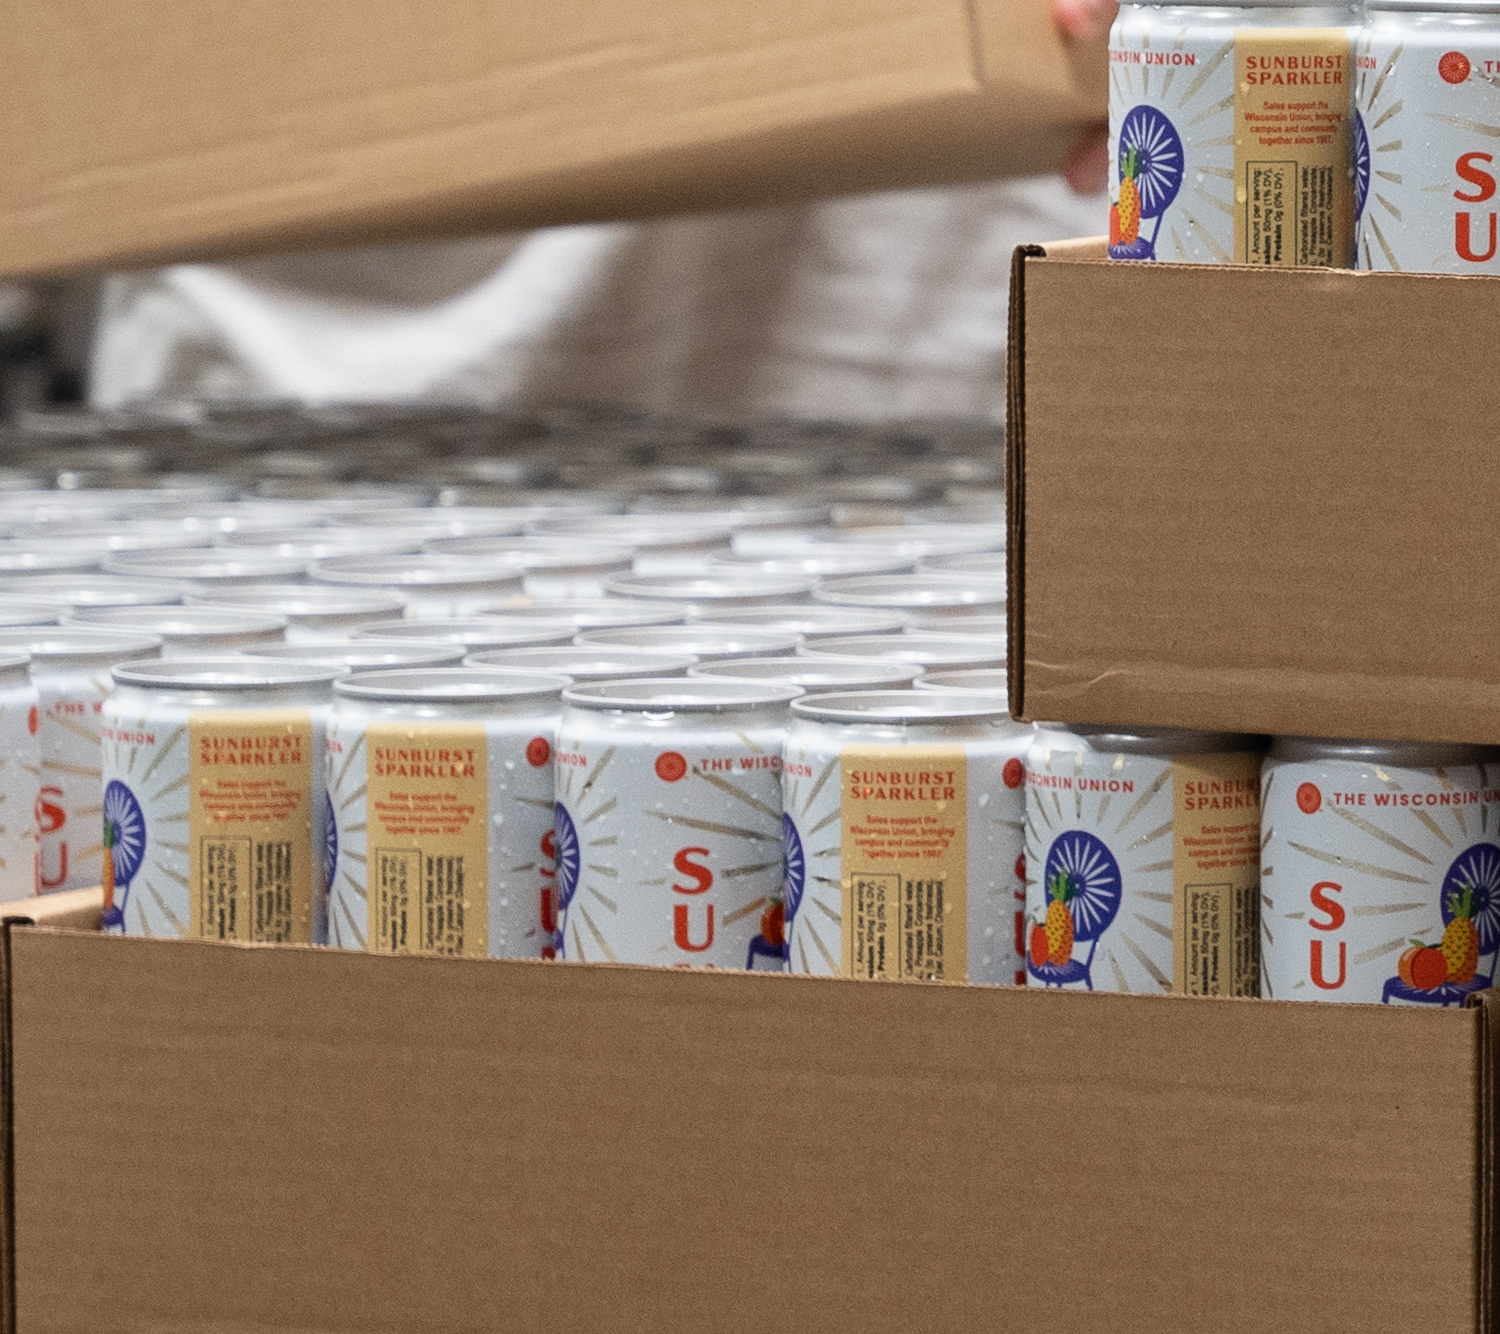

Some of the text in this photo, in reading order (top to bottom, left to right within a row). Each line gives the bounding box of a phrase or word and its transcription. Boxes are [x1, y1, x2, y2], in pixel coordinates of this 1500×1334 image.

[1146, 52, 1196, 66] UNION
[1246, 55, 1342, 69] SUNBURST
[1246, 71, 1342, 85] SPARKLER
[375, 748, 475, 762] SUNBURST
[375, 763, 476, 778] SPARKLER
[701, 758, 733, 771] THE
[851, 770, 955, 784] SUNBURST
[1078, 778, 1134, 792] UNION
[851, 786, 955, 800] SPARKLER
[1333, 792, 1366, 806] THE
[1374, 790, 1478, 806] WISCONSIN
